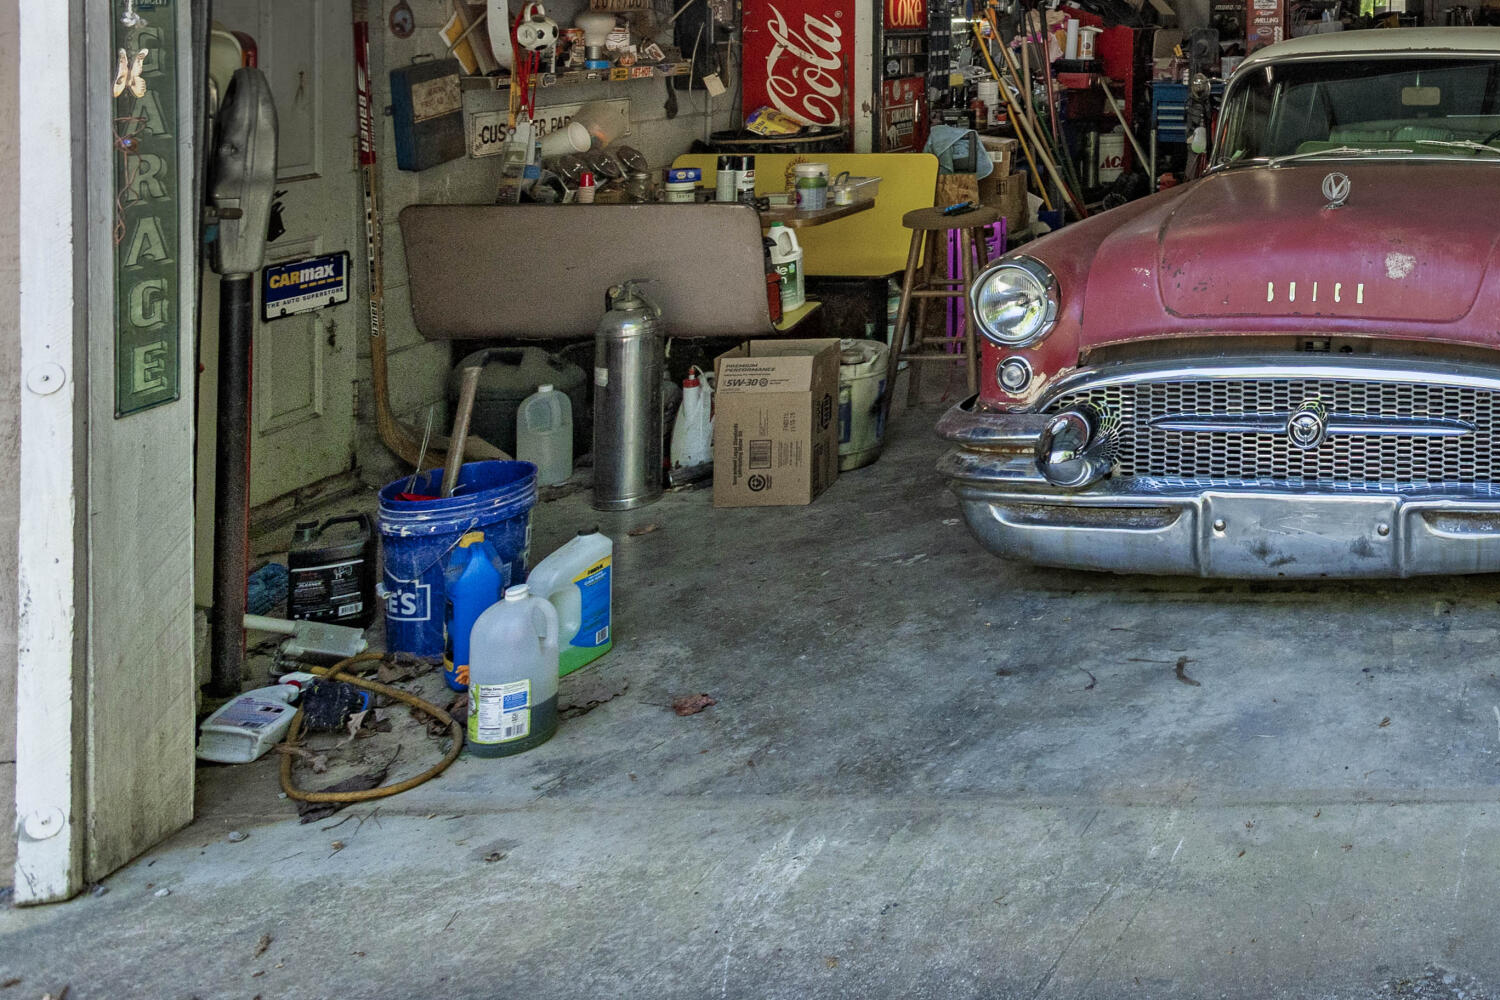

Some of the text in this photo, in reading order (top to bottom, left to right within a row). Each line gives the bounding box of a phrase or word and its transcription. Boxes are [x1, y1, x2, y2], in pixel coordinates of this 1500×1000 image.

[122, 25, 174, 396] GARAGE
[283, 297, 300, 305] AUTO
[302, 287, 344, 301] SUPERSTORE
[1267, 281, 1364, 304] BUICK
[726, 378, 758, 387] 5W-30
